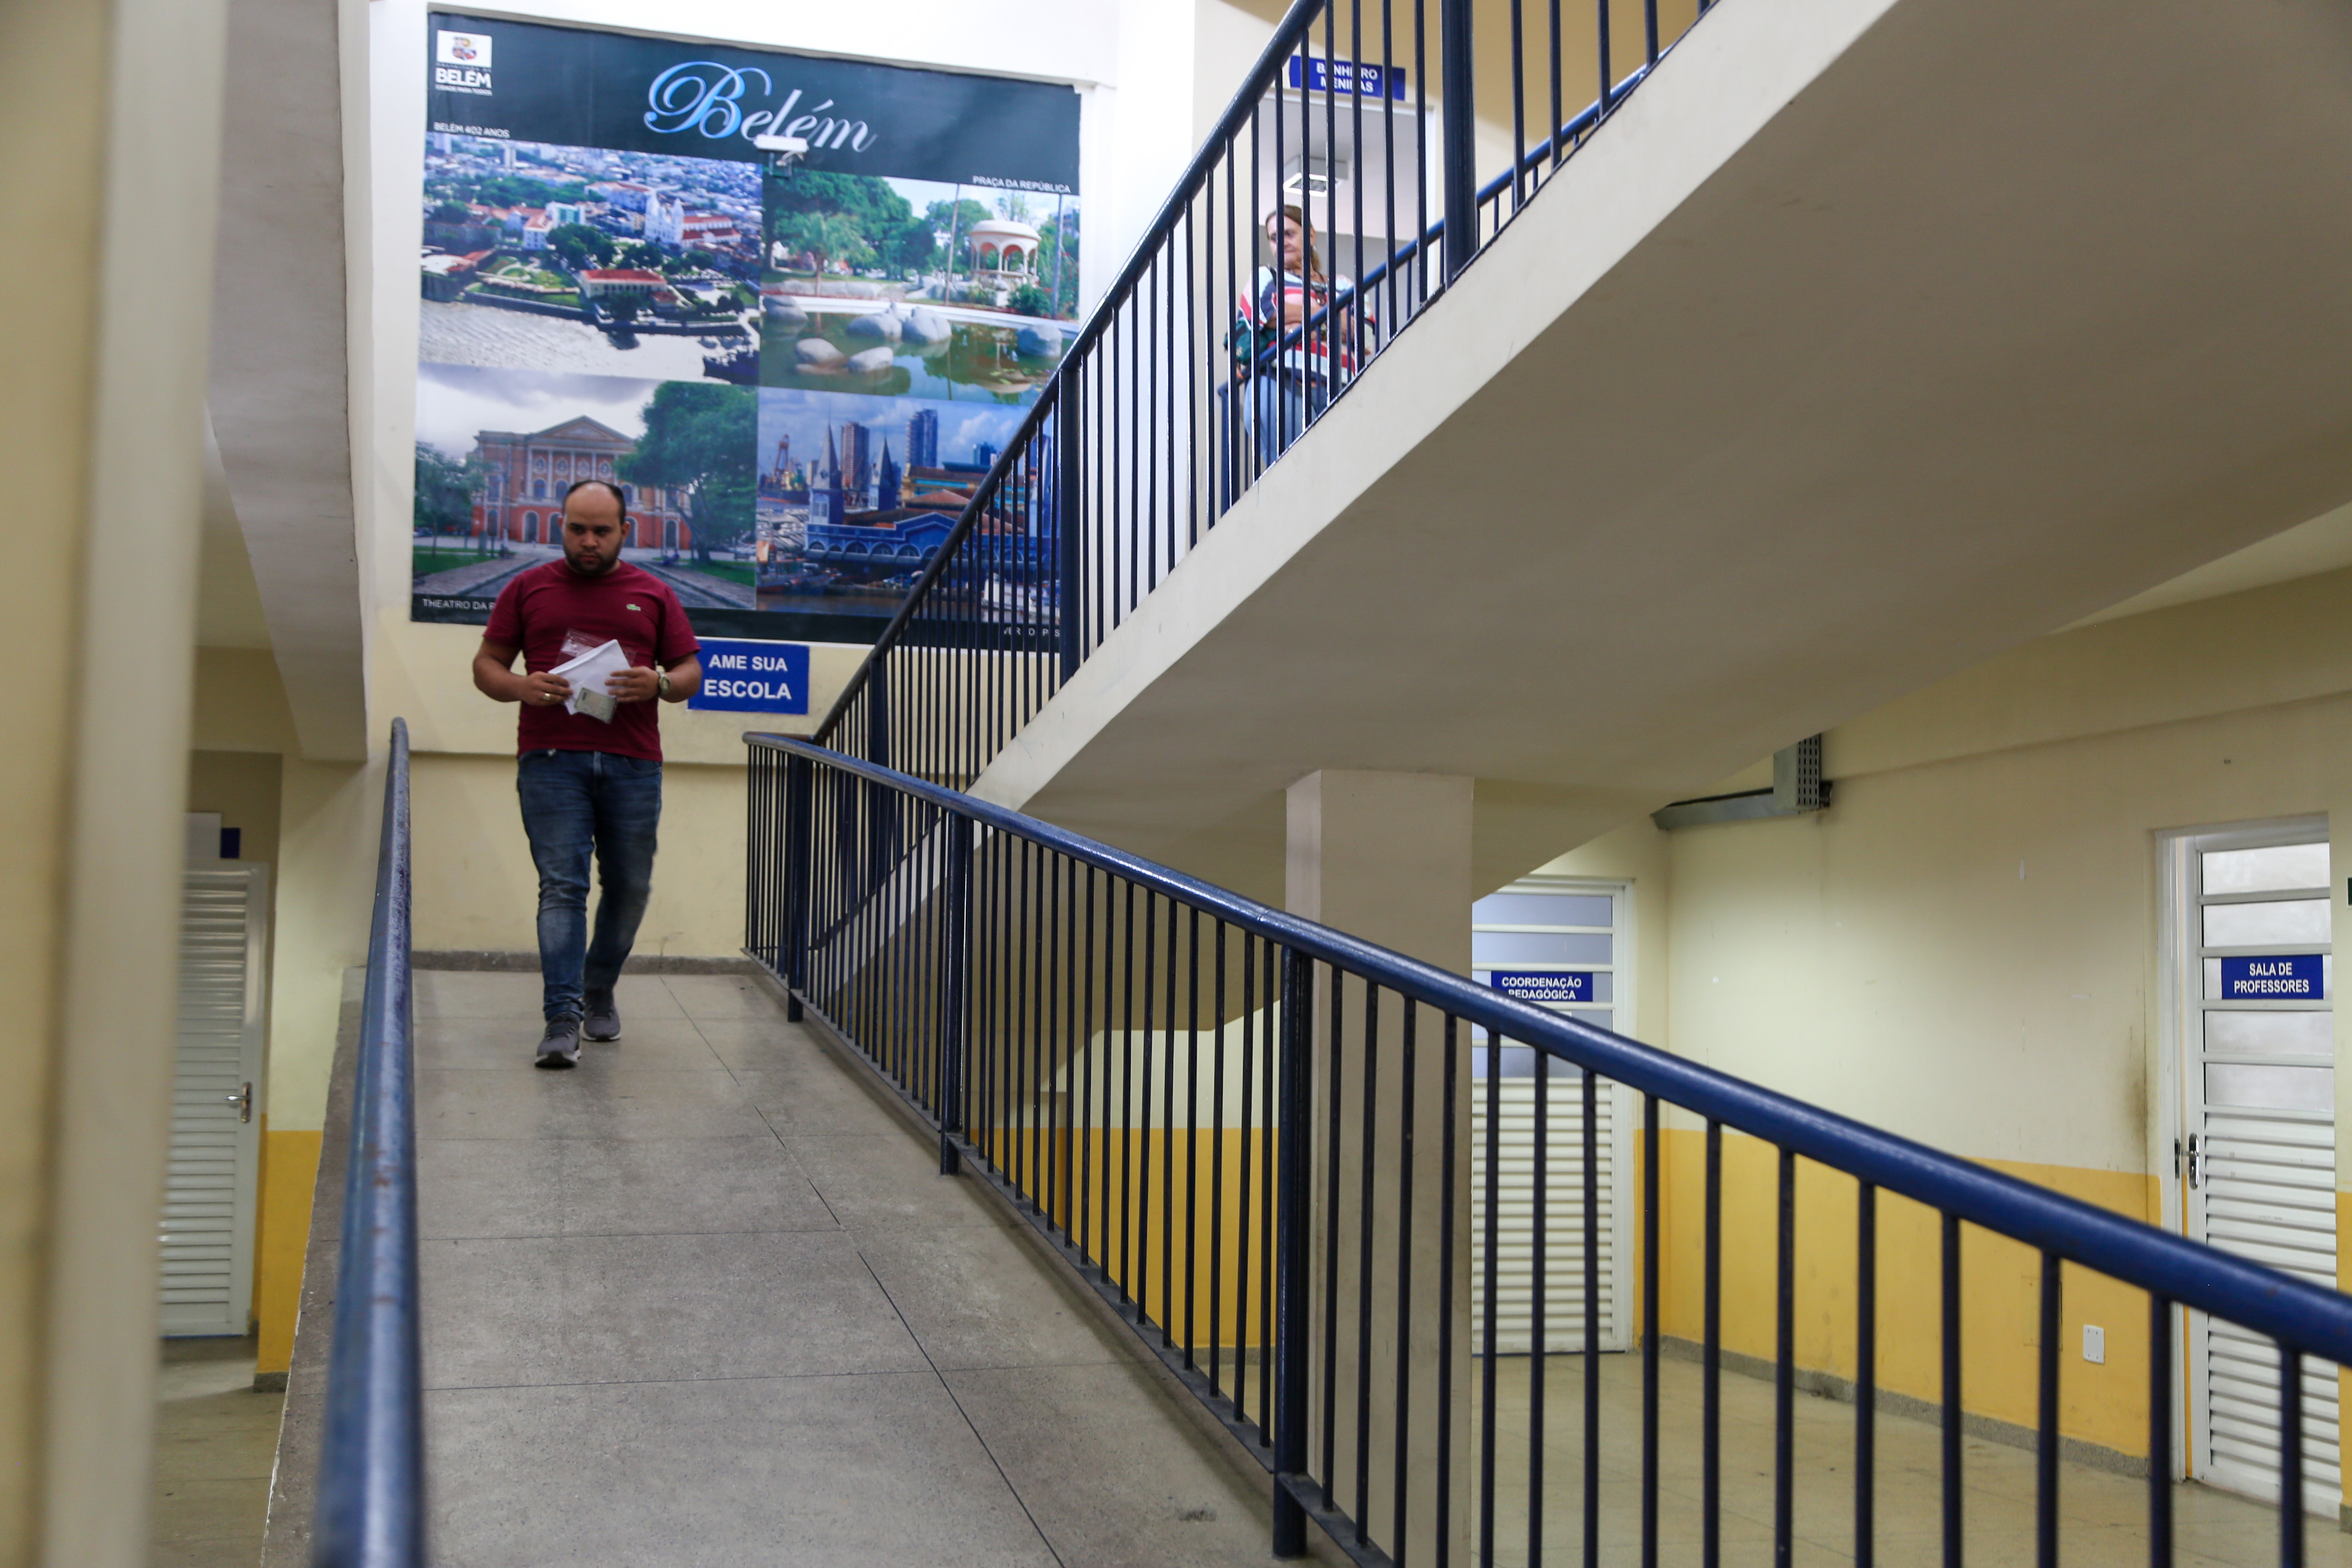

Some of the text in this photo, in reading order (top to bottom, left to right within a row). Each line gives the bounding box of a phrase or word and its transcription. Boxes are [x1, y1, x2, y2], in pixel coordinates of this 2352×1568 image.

[435, 67, 492, 89] BELÉM
[1316, 62, 1378, 80] BNHRO
[644, 61, 878, 152] Belém
[464, 125, 483, 135] 402
[483, 127, 511, 138] ANOS
[973, 175, 1071, 194] PRAÇA DA REPÚBLICA
[423, 598, 471, 609] THEATRO
[472, 601, 488, 610] DA
[708, 654, 788, 672] AME SUA
[704, 679, 792, 699] ESCOLA
[2249, 962, 2293, 976] SALA DE
[1502, 976, 1582, 989] COORDENAÇÃO
[2234, 979, 2310, 993] PROFESSORES
[1508, 987, 1577, 1000] PEDAGÓGICA
